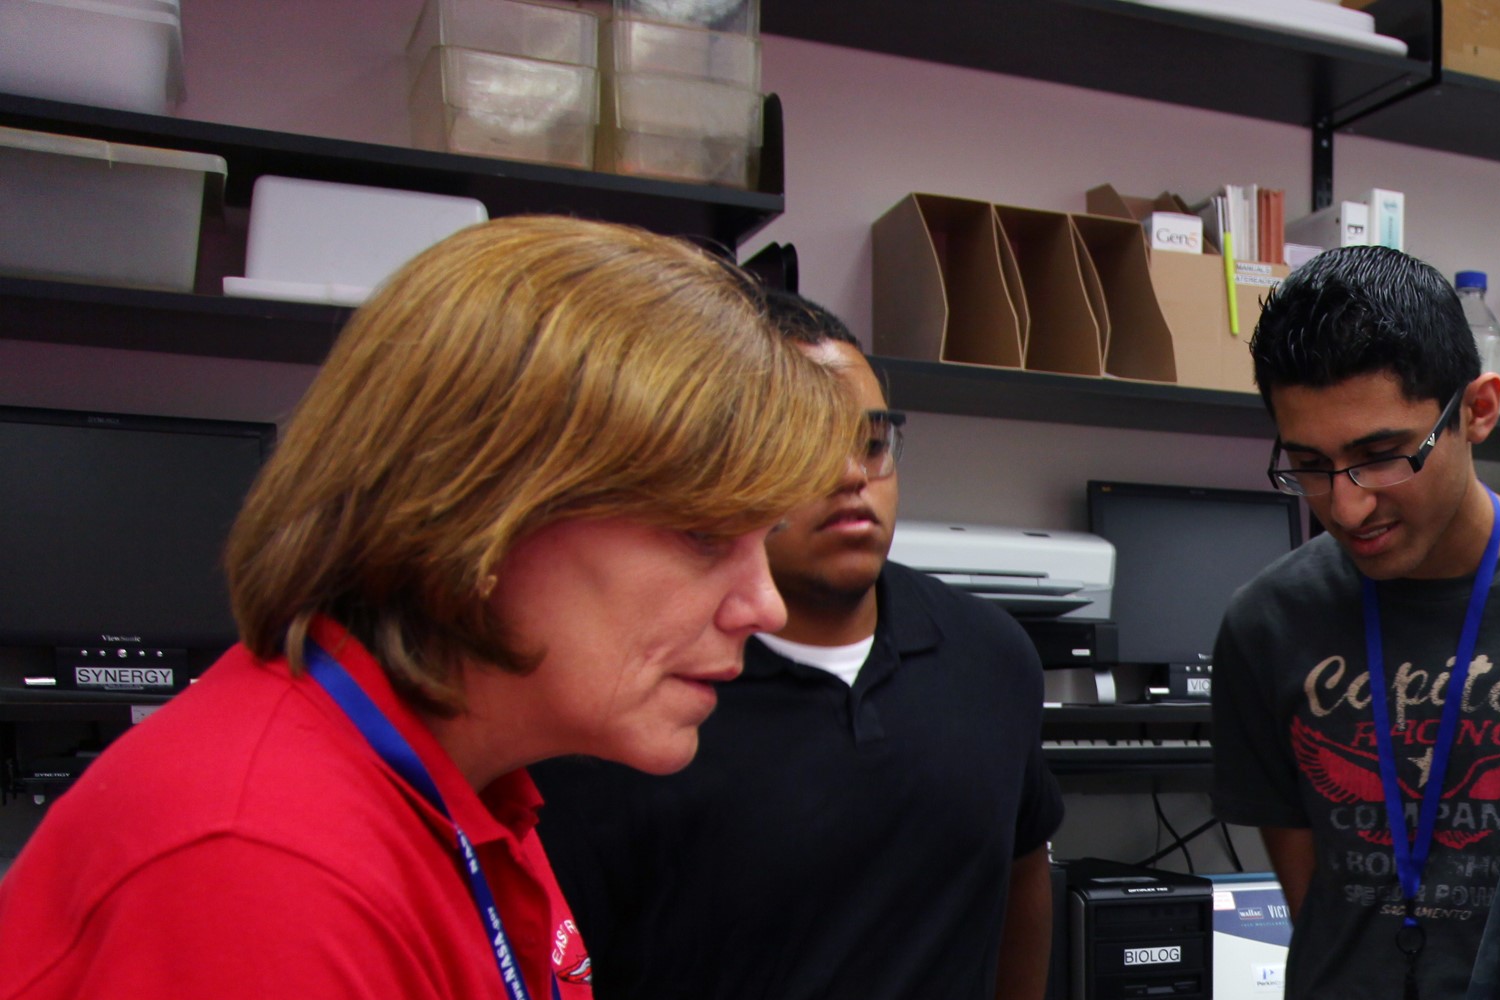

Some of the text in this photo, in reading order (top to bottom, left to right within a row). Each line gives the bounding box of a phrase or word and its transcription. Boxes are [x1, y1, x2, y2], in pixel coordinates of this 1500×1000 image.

[78, 669, 171, 684] SYNERGY
[1267, 904, 1290, 919] VICT
[1380, 904, 1472, 920] SACAMENTO
[1125, 948, 1180, 964] BIOLOG
